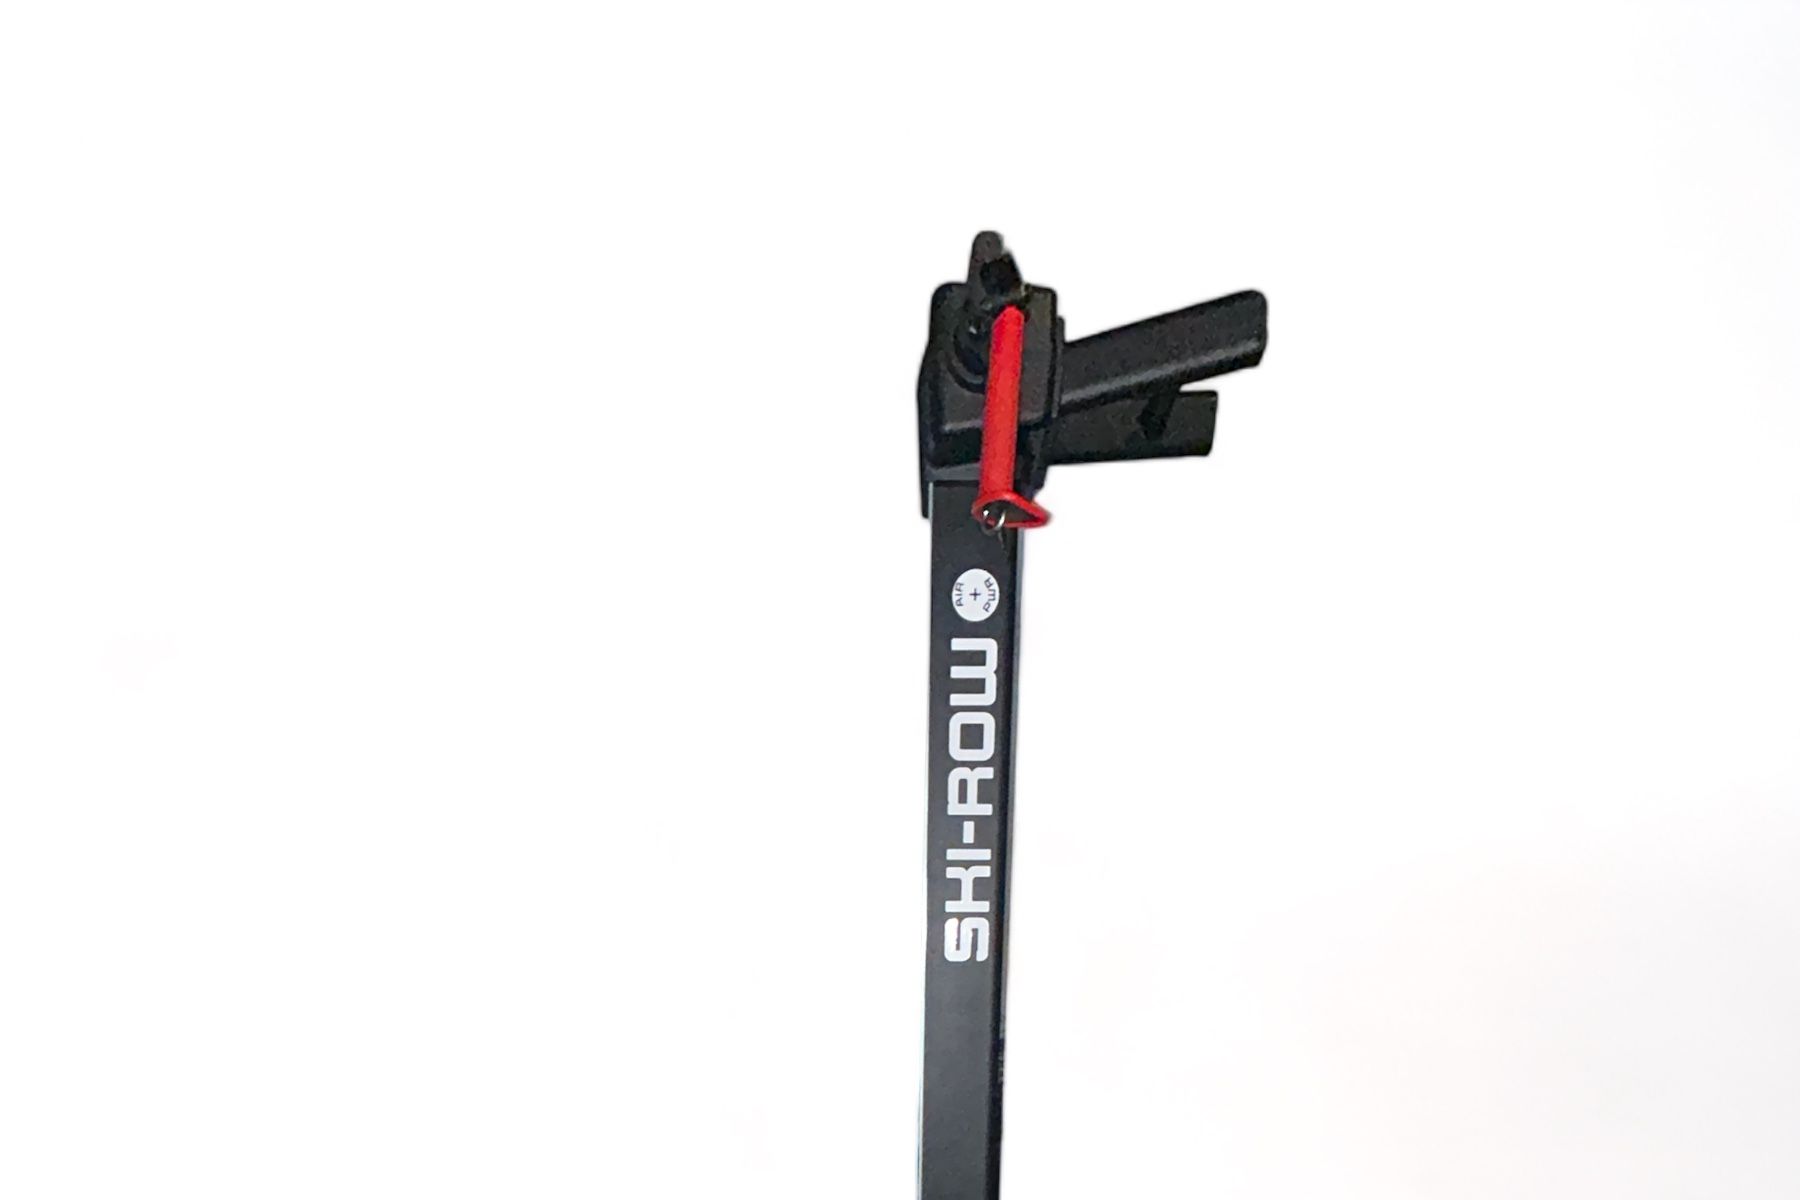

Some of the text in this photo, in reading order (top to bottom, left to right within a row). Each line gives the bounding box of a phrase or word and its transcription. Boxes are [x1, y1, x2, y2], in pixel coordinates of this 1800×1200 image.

[955, 582, 964, 607] AIR
[983, 577, 996, 612] PWR
[944, 638, 998, 963] SKI-ROW
